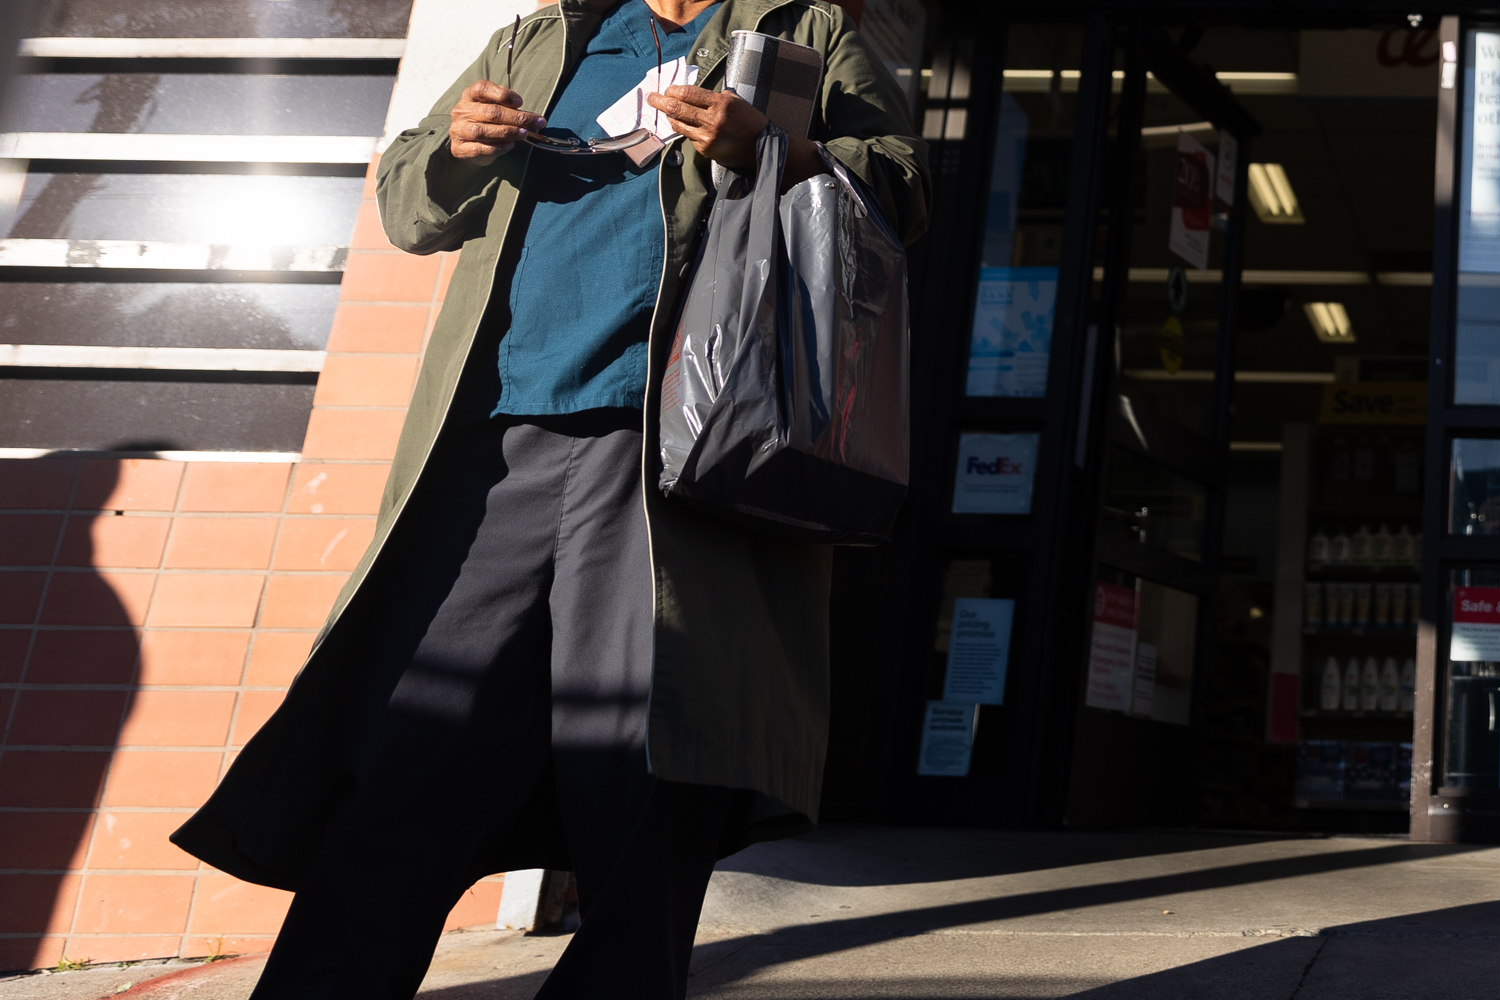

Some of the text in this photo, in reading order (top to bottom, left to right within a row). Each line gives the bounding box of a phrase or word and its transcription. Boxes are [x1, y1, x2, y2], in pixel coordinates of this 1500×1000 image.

[1333, 389, 1393, 413] Save
[967, 456, 1021, 475] FedEx
[1460, 599, 1493, 613] Safe
[959, 609, 977, 619] Our
[957, 619, 990, 630] pricing
[956, 629, 996, 639] promise
[931, 707, 964, 716] Service
[930, 716, 963, 724] animals
[929, 724, 967, 732] welcome
